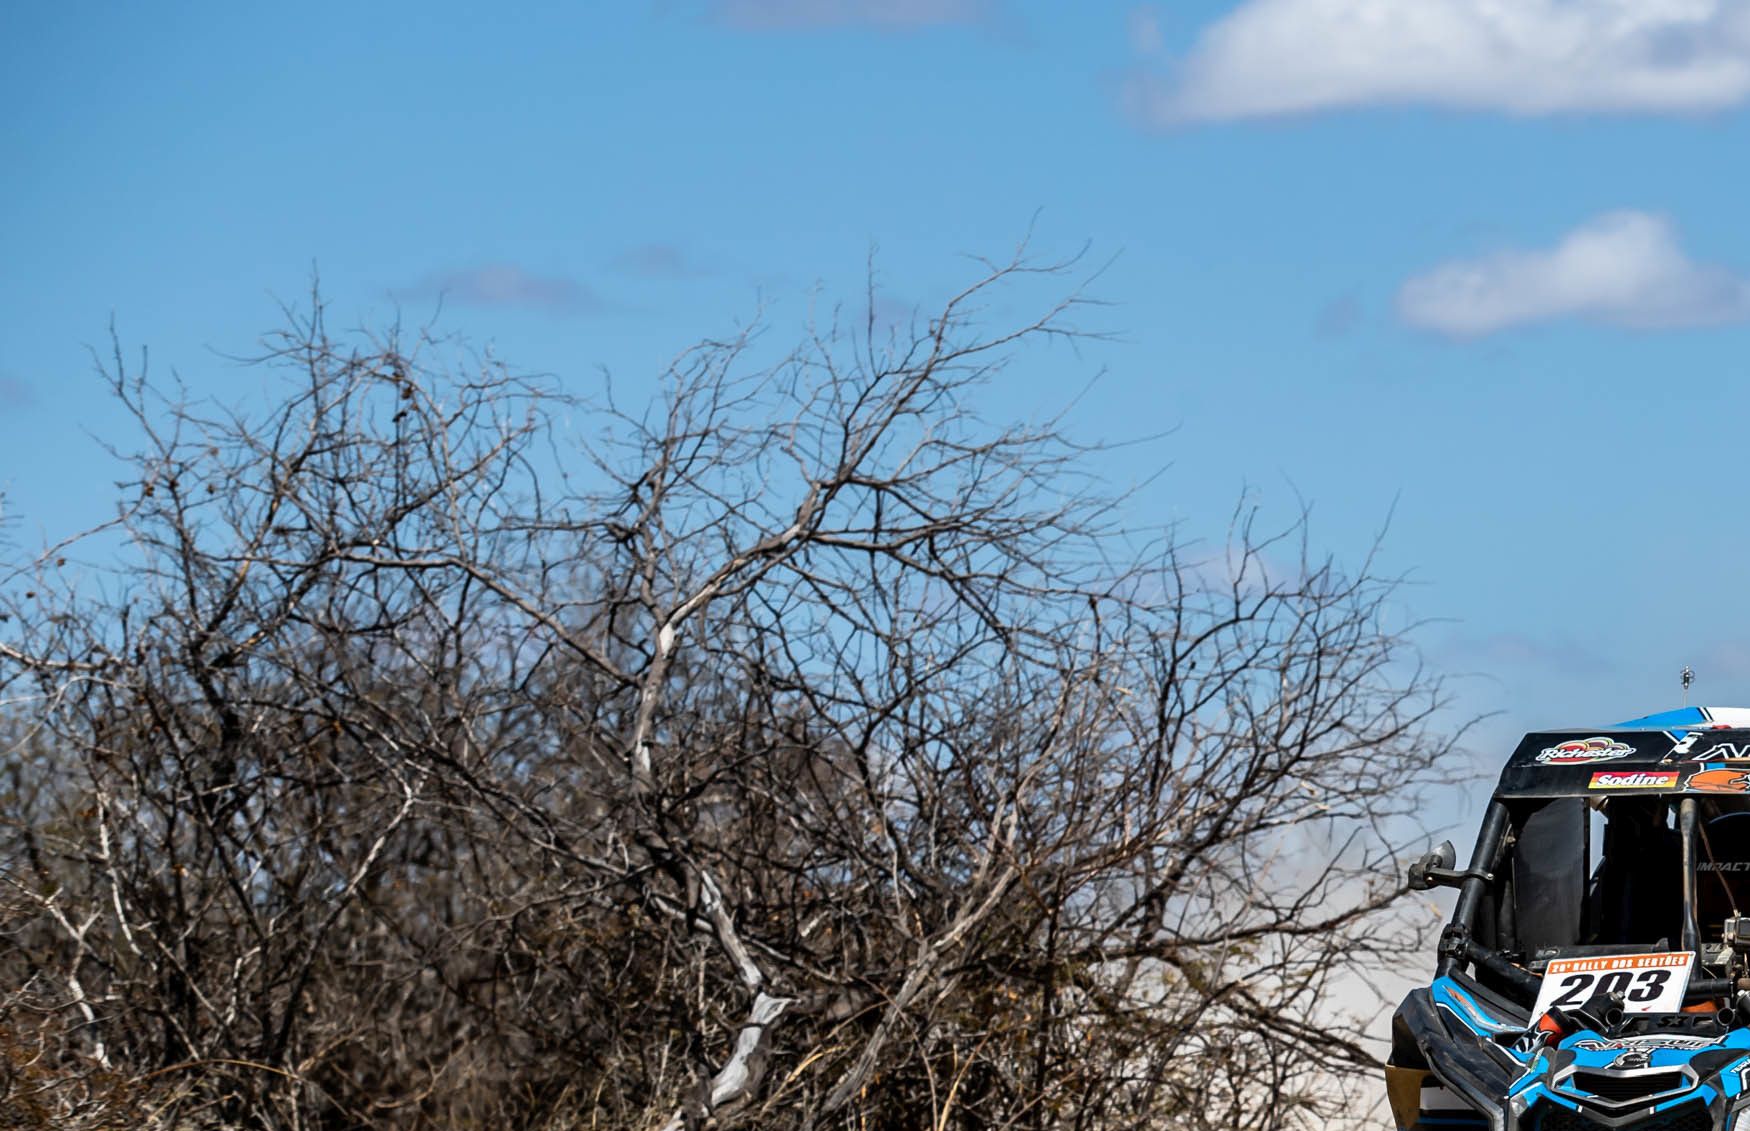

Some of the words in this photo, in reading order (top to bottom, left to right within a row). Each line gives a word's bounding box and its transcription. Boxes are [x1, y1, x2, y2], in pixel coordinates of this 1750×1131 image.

[1538, 746, 1635, 760] Richester
[1596, 774, 1669, 787] Sodine
[1573, 960, 1608, 971] RALLY
[1550, 969, 1672, 1006] 203
